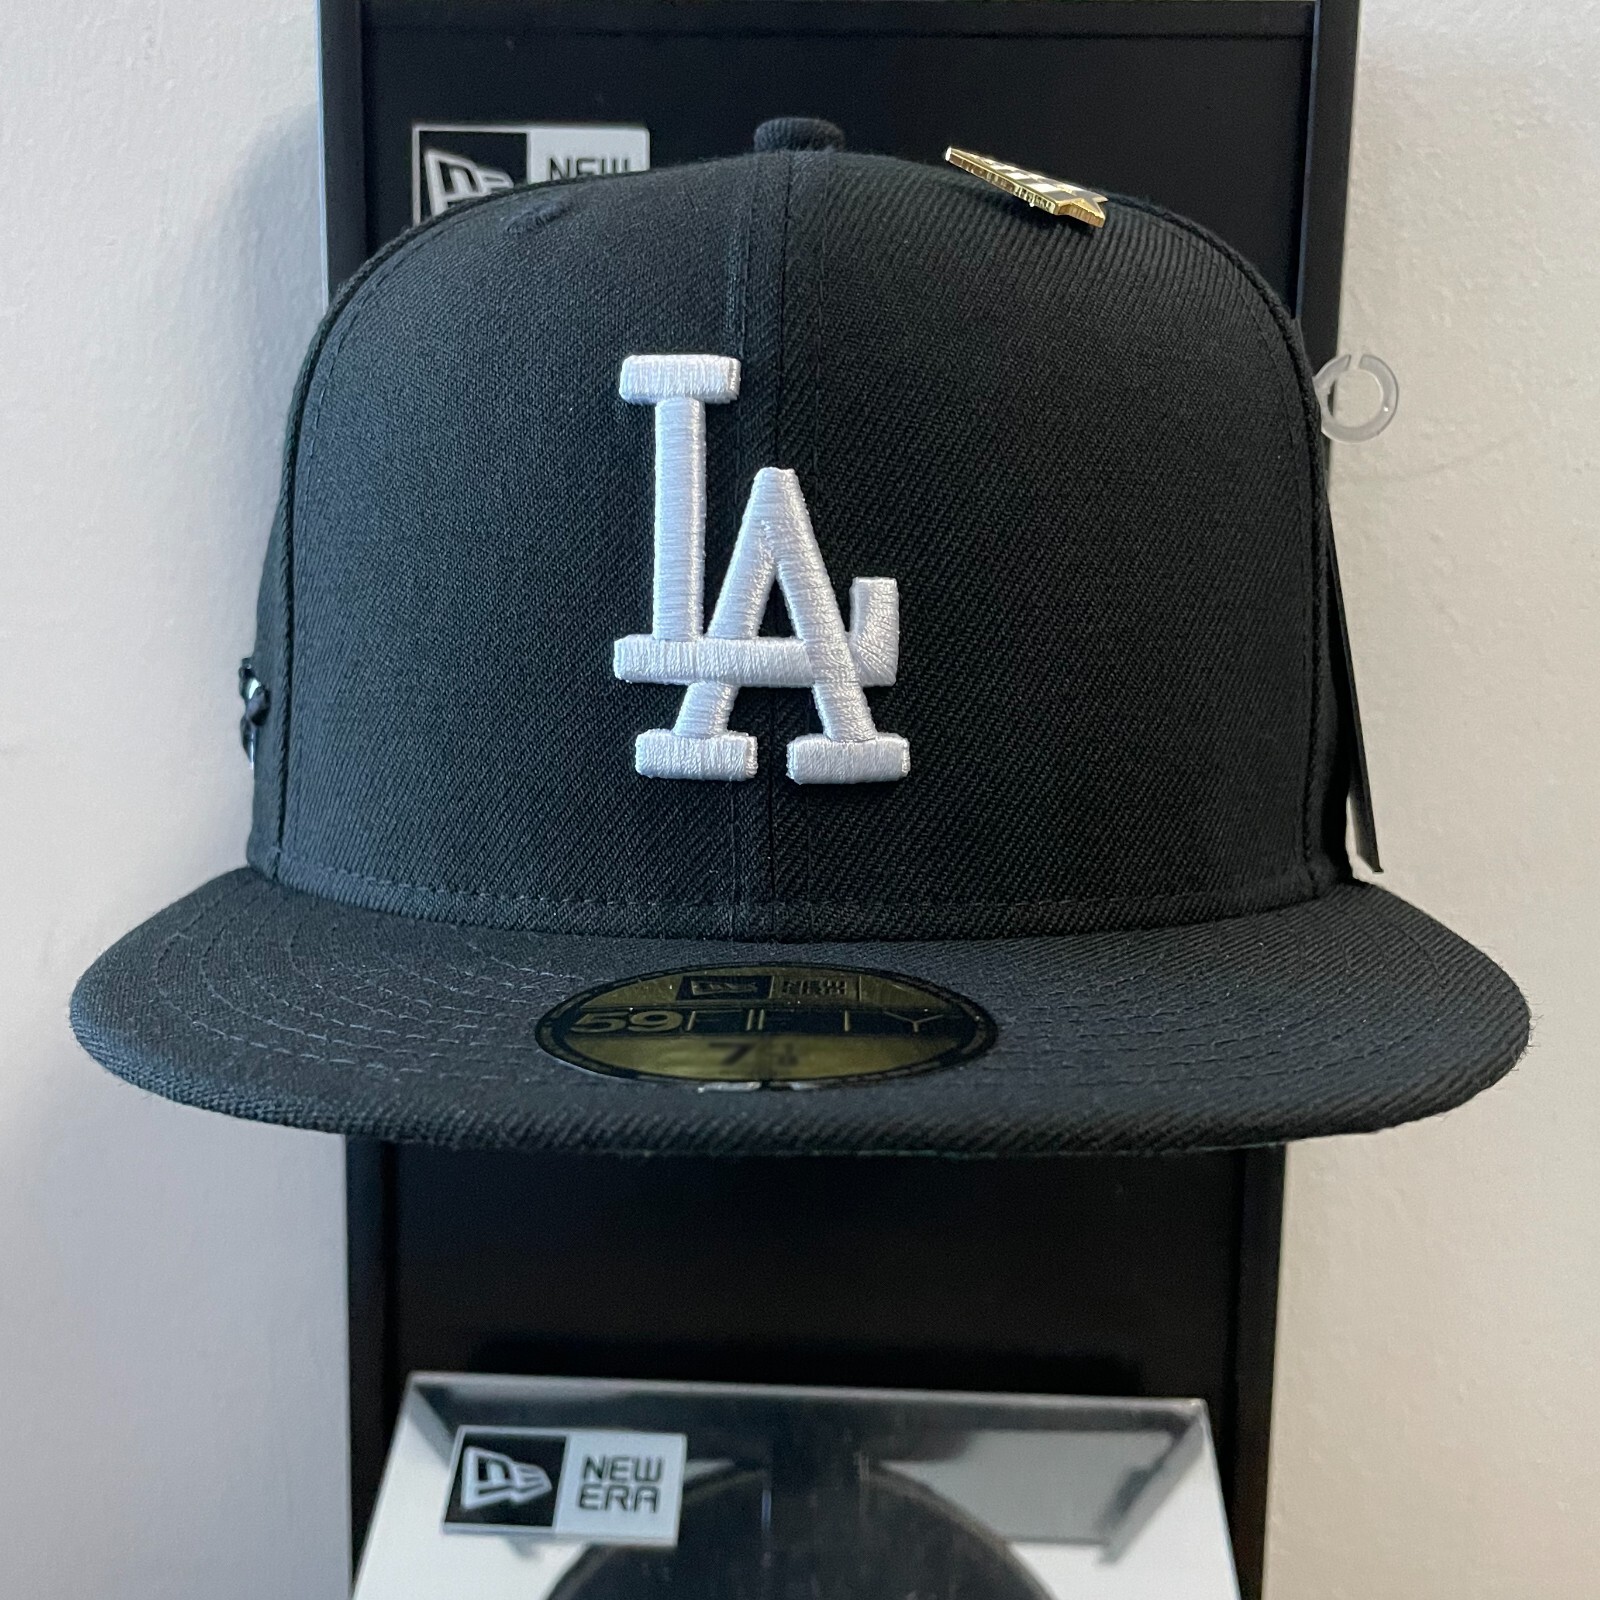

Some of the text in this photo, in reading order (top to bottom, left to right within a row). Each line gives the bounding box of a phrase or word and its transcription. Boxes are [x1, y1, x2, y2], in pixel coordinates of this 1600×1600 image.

[614, 354, 910, 785] LA
[583, 1455, 663, 1483] NEW
[579, 1484, 661, 1512] ERA
